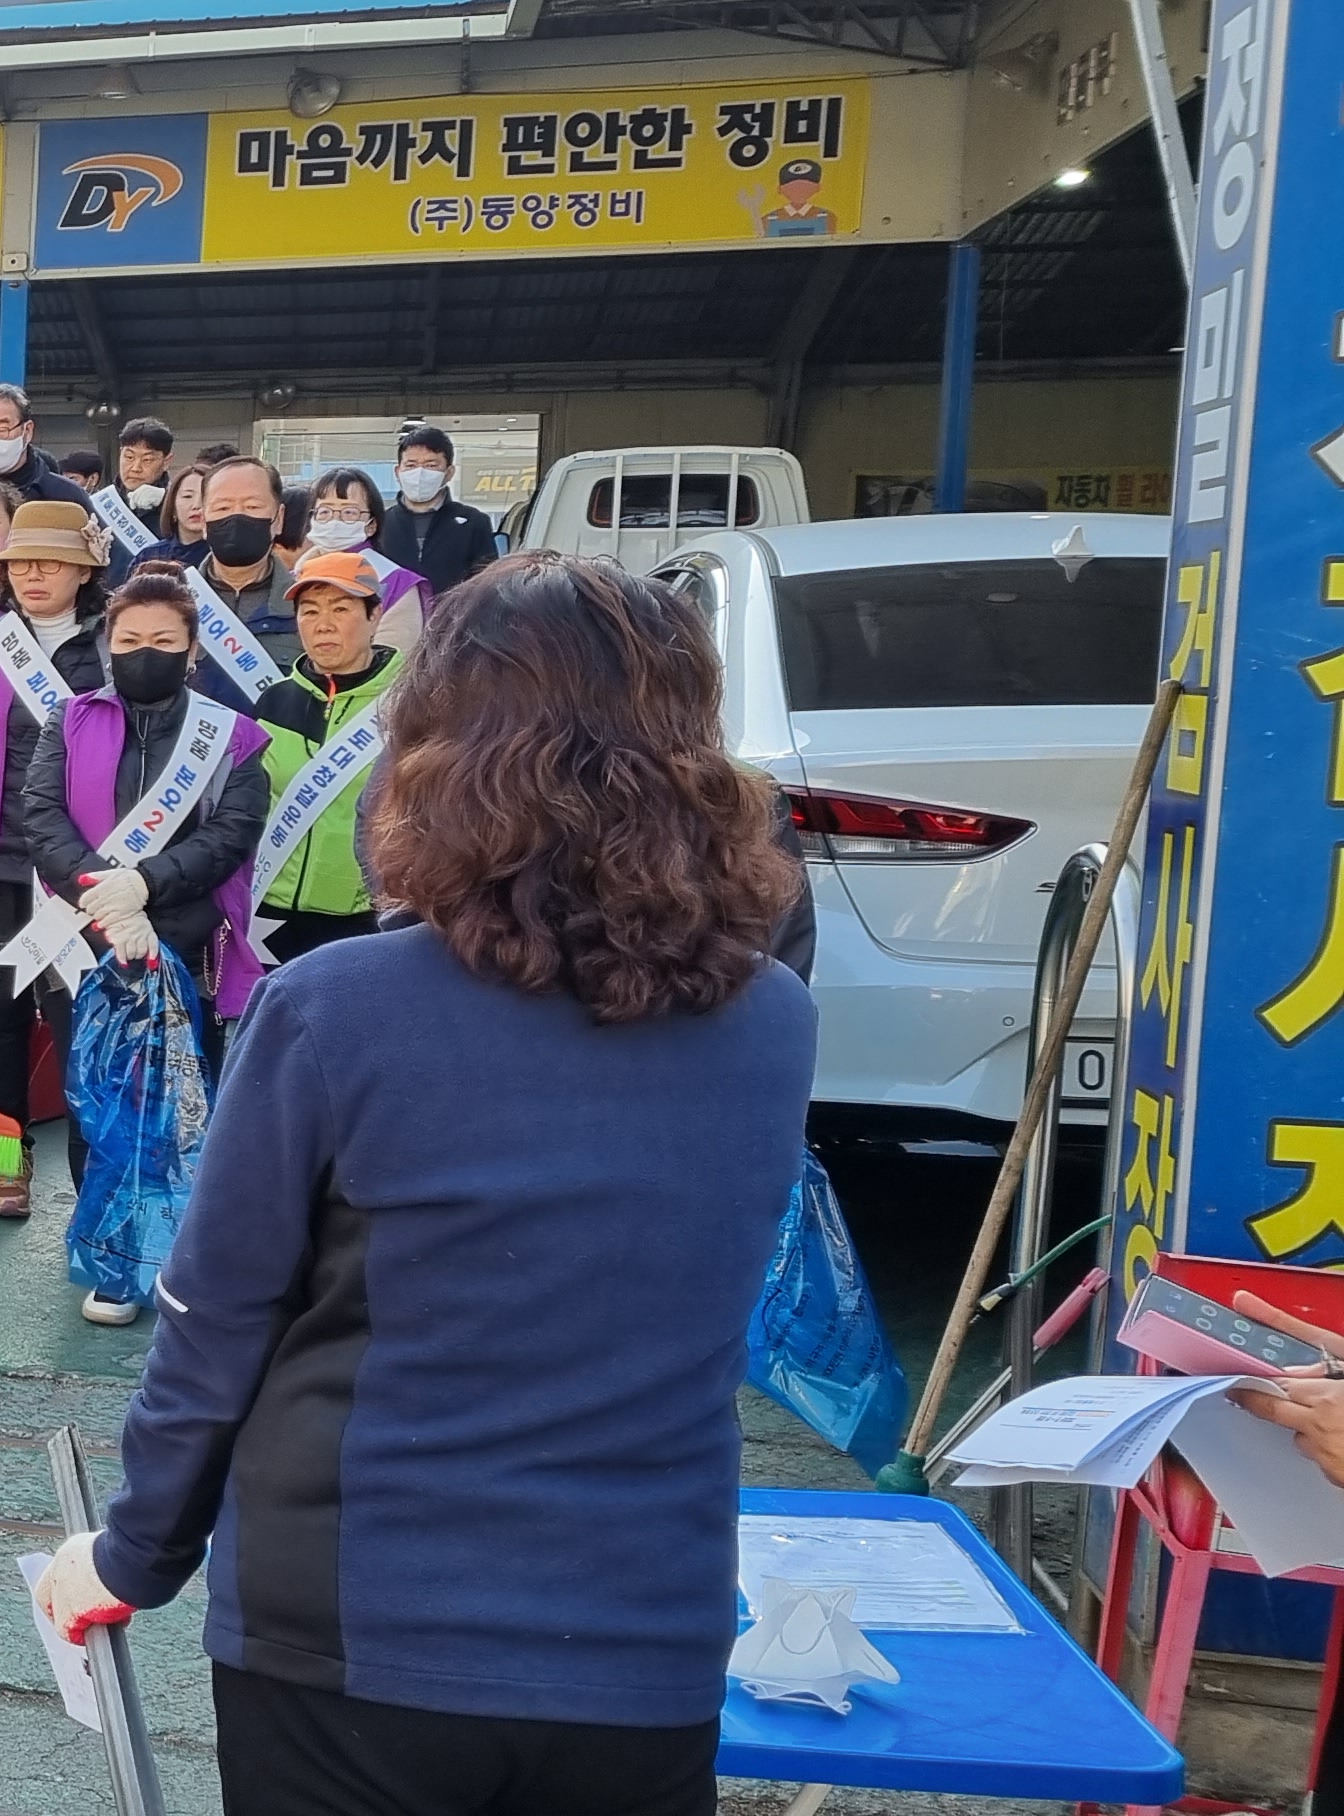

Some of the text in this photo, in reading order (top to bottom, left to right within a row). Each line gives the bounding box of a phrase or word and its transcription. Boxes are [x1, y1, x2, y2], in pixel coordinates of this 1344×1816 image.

[235, 96, 844, 189] 마음까지 편안한 정비
[59, 169, 158, 233] DY
[409, 188, 646, 235] (주)동양정비
[474, 475, 517, 492] ALL
[1055, 473, 1111, 508] 자동차
[2, 630, 33, 670] 명품
[123, 718, 219, 854] 명품 본오2동
[269, 718, 377, 849] 토대청결운동
